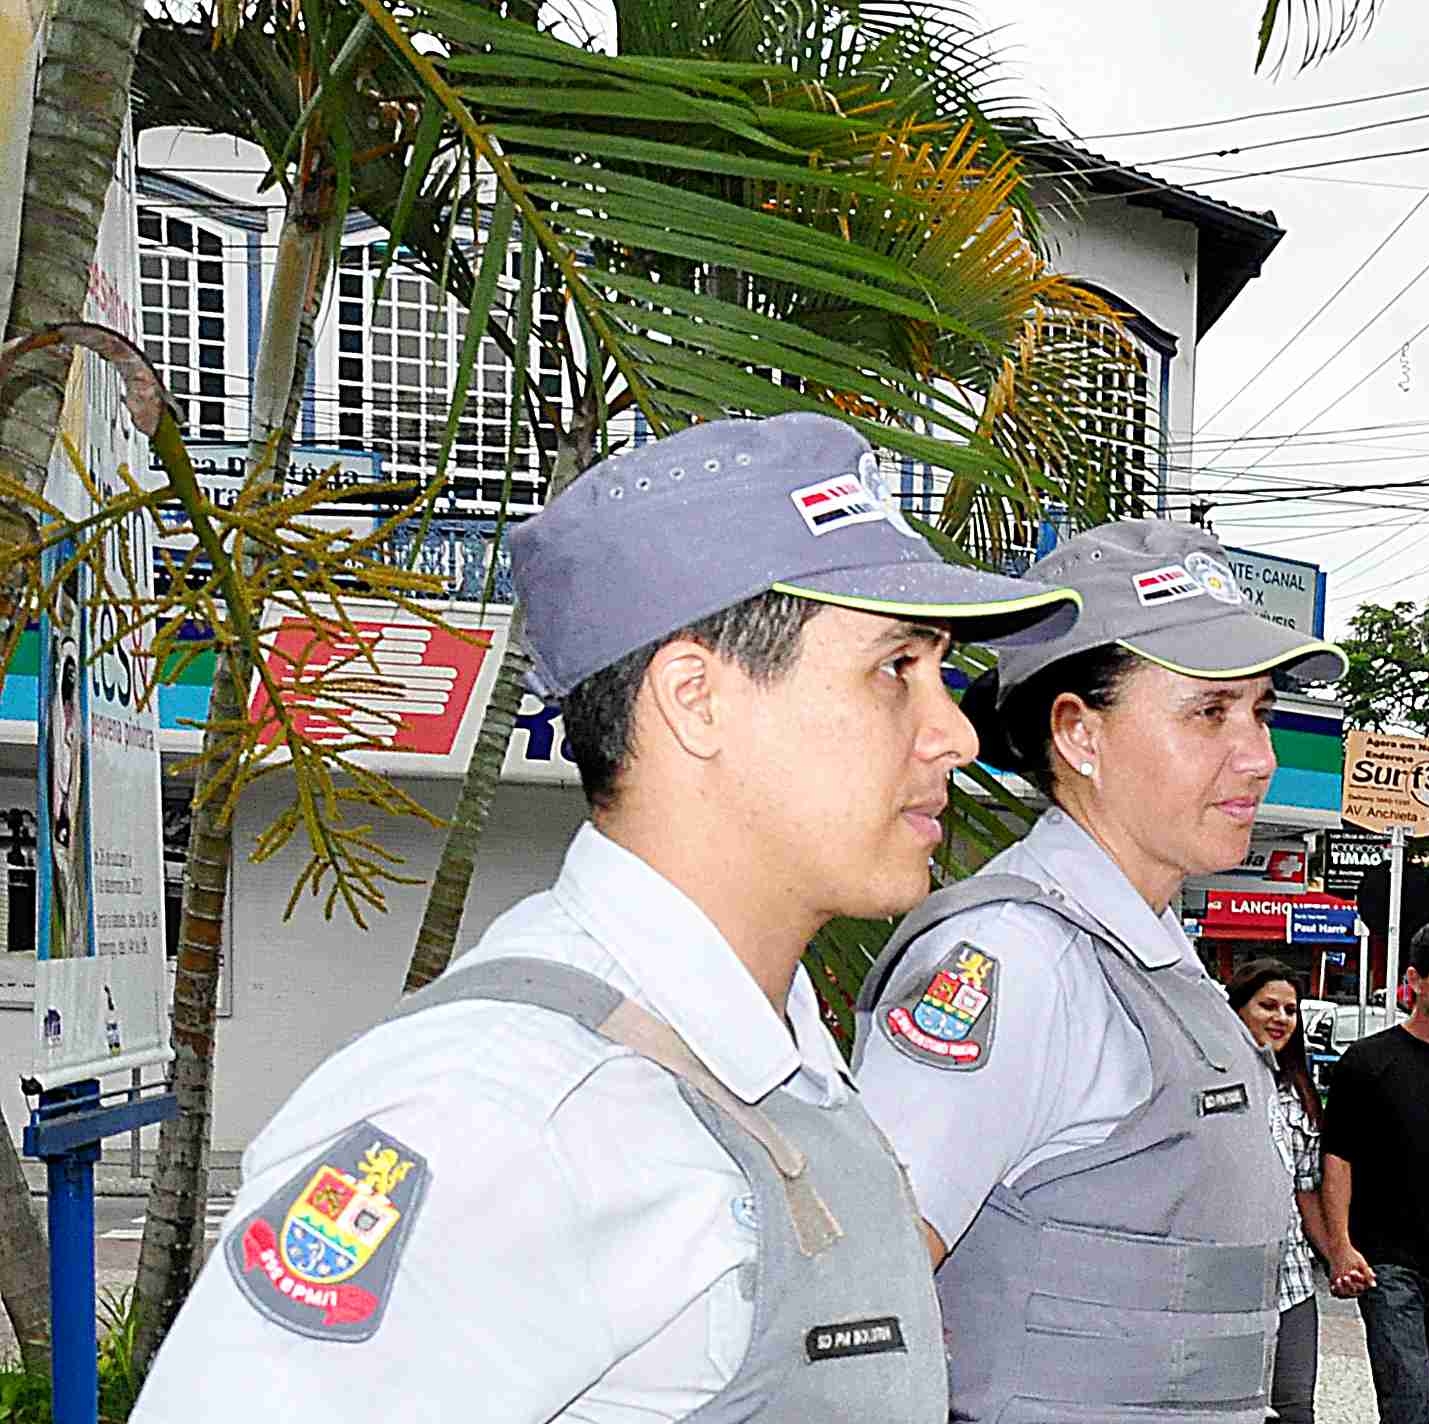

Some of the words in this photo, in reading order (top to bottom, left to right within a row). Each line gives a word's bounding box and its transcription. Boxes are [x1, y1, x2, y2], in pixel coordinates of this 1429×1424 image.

[1262, 567, 1306, 592] CANAL
[1366, 737, 1397, 748] Agora
[1399, 742, 1416, 750] em
[1365, 750, 1414, 763] Endereço
[1366, 807, 1418, 822] Anchieta
[1294, 923, 1316, 933] Paul
